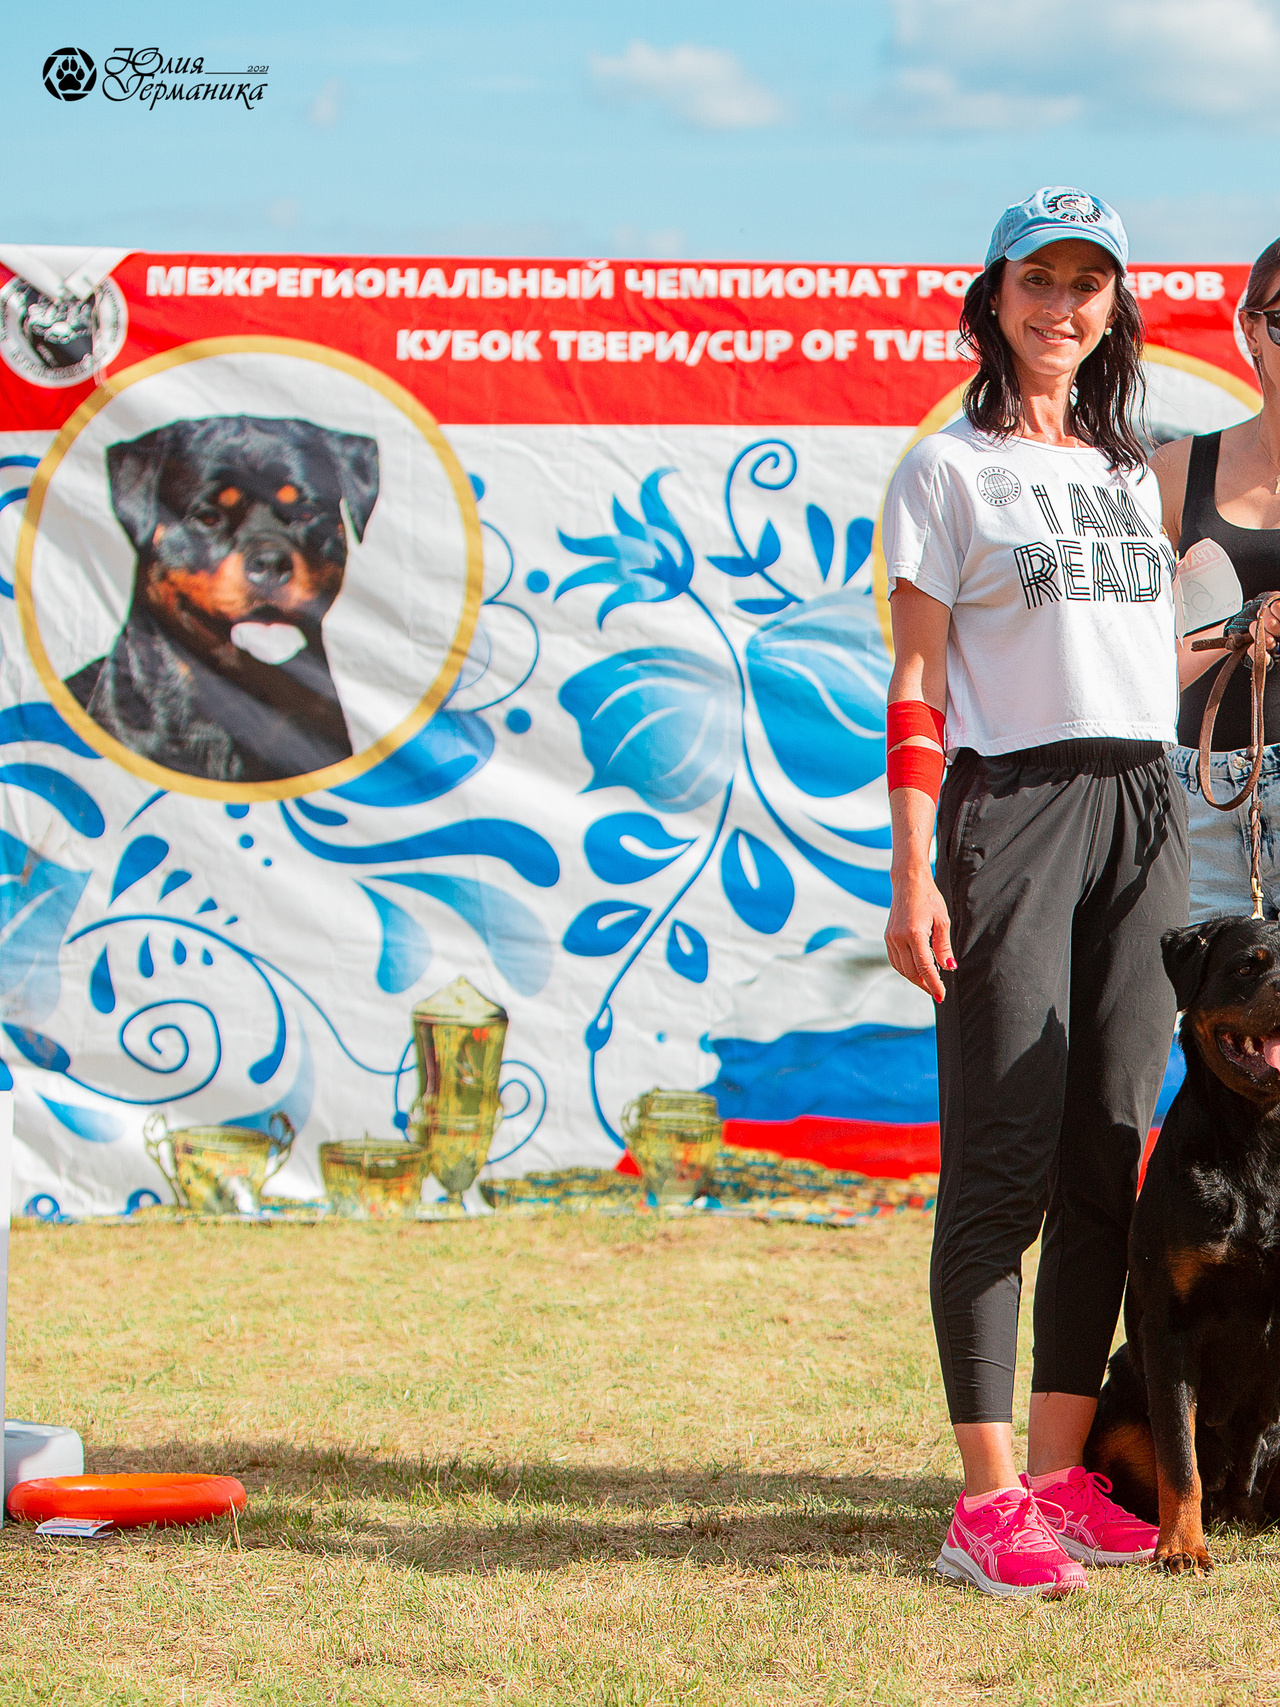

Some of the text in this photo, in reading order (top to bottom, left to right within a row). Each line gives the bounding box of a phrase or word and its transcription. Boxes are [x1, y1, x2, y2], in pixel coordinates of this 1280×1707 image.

[147, 259, 615, 300] МЕЖРЕГИОНАЛЬНЫЙ
[625, 269, 907, 299] ЧЕМПИОНАТ
[396, 330, 542, 362] КУБОК
[549, 330, 792, 367] ТВЕРИ/CUP
[801, 330, 858, 362] OF
[1031, 483, 1153, 537] I AM
